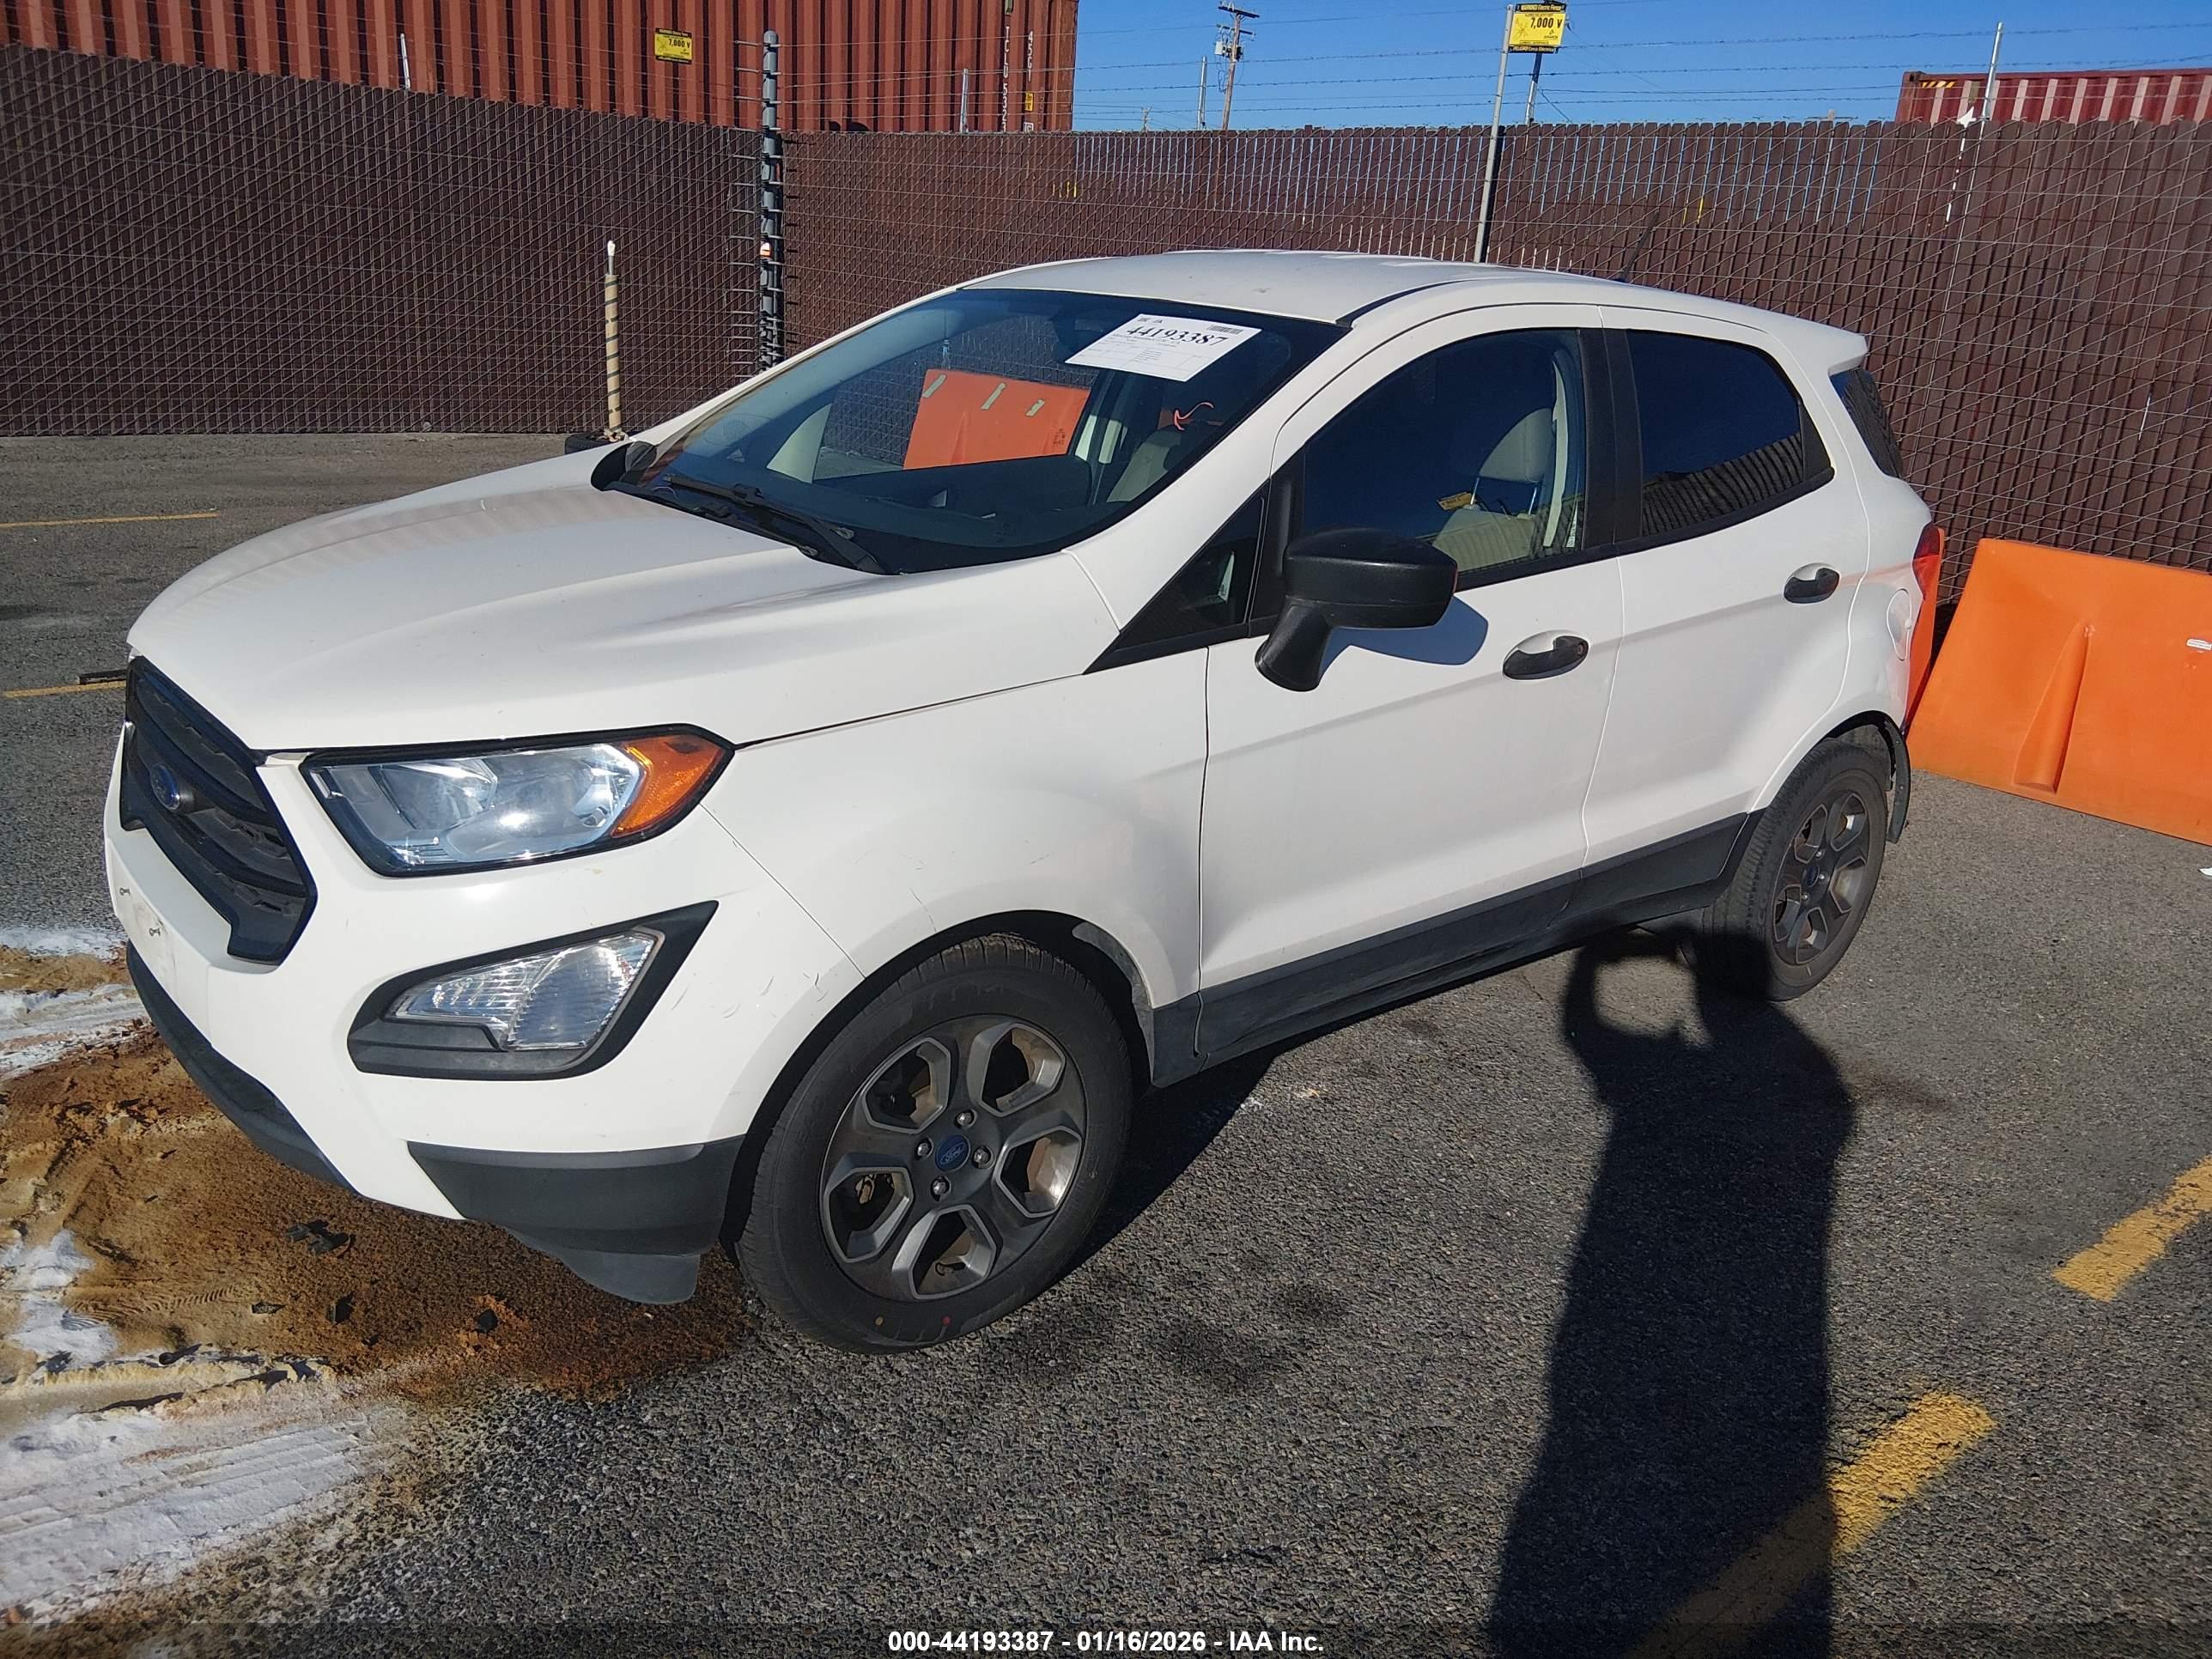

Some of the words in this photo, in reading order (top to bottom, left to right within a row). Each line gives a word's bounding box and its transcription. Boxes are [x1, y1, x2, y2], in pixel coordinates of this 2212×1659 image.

[1531, 17, 1554, 29] 7,000
[1557, 19, 1563, 28] V
[669, 39, 684, 47] 7,000
[1127, 325, 1229, 347] 44193387
